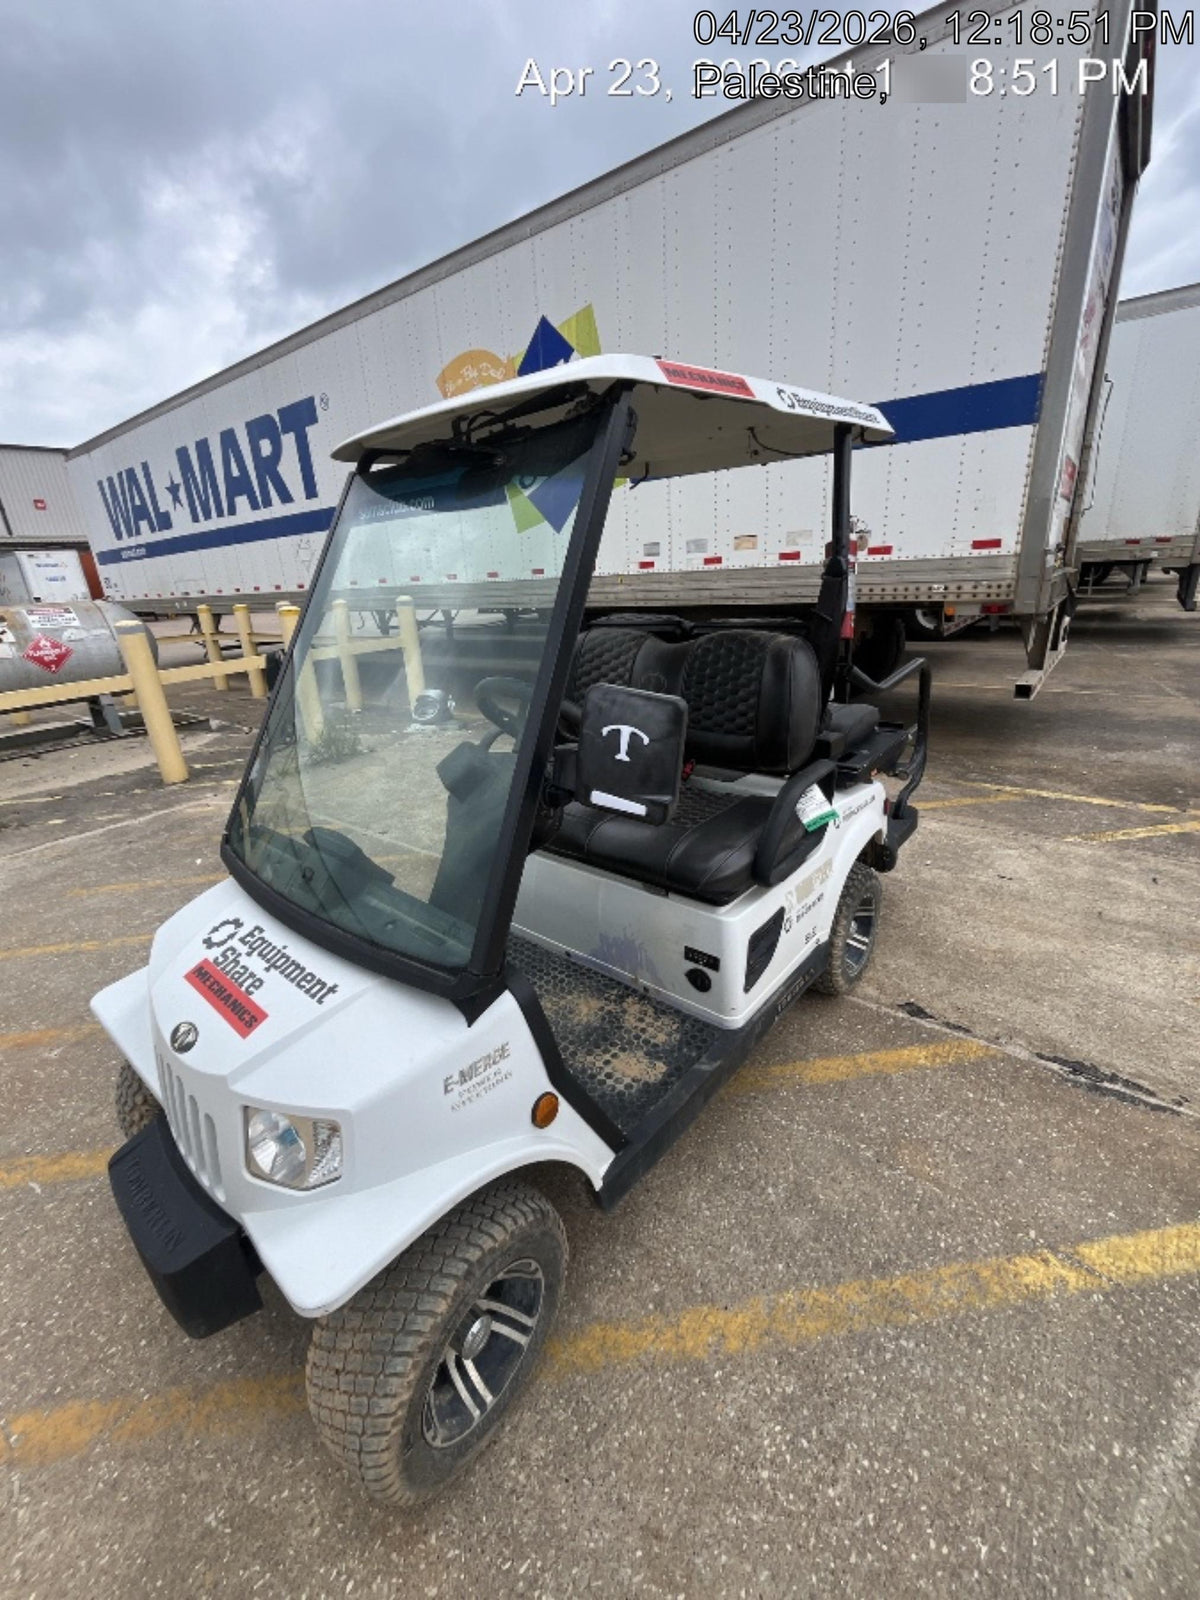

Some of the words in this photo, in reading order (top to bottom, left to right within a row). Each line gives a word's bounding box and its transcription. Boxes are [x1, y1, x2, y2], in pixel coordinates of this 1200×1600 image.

[190, 964, 259, 1031] MECHANICS
[213, 945, 264, 997] Share
[238, 925, 339, 1005] Equipment
